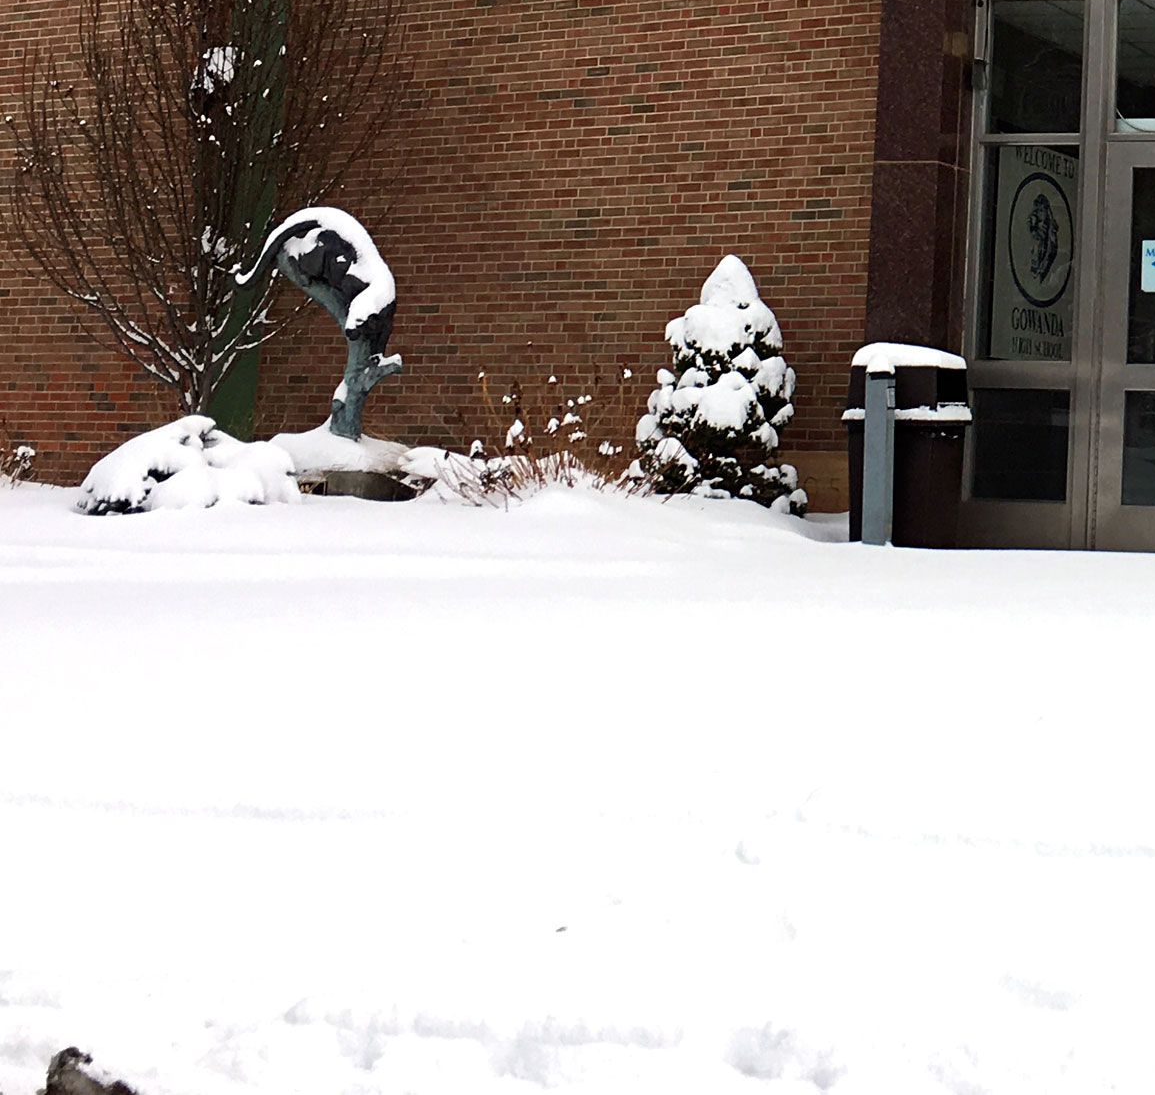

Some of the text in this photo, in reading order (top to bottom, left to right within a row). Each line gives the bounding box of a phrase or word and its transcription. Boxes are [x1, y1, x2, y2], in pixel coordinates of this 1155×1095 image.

[1015, 146, 1076, 179] WELCOME TO
[1011, 307, 1065, 337] GOWANDA
